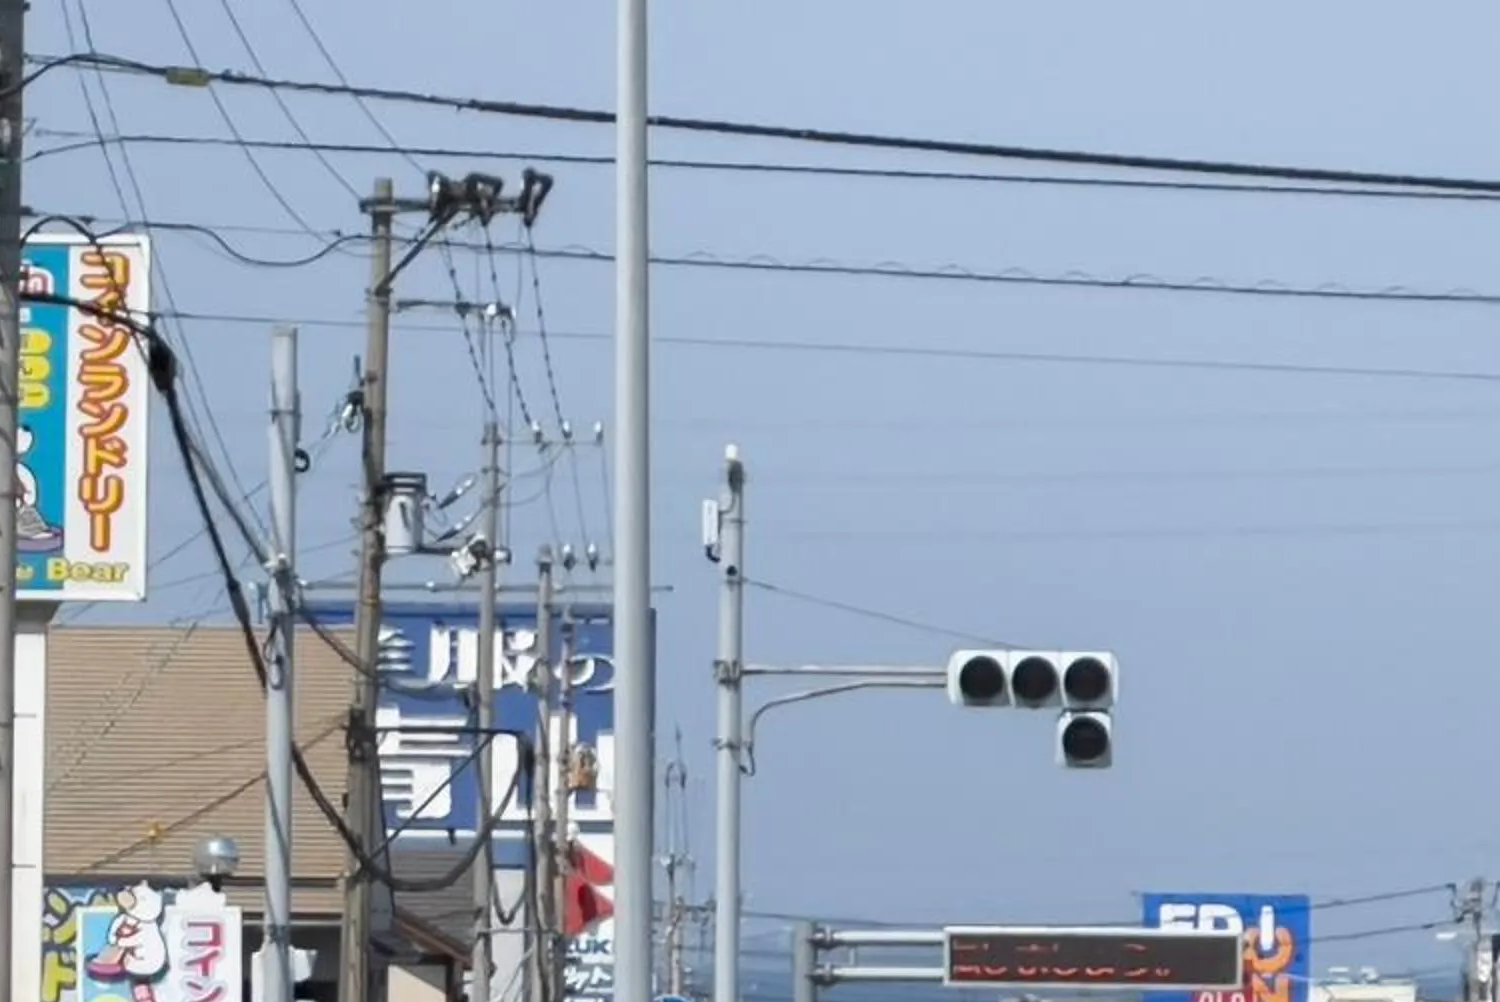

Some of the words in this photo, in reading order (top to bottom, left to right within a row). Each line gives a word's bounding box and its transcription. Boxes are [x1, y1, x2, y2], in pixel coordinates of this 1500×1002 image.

[77, 250, 130, 553] コインランドリー
